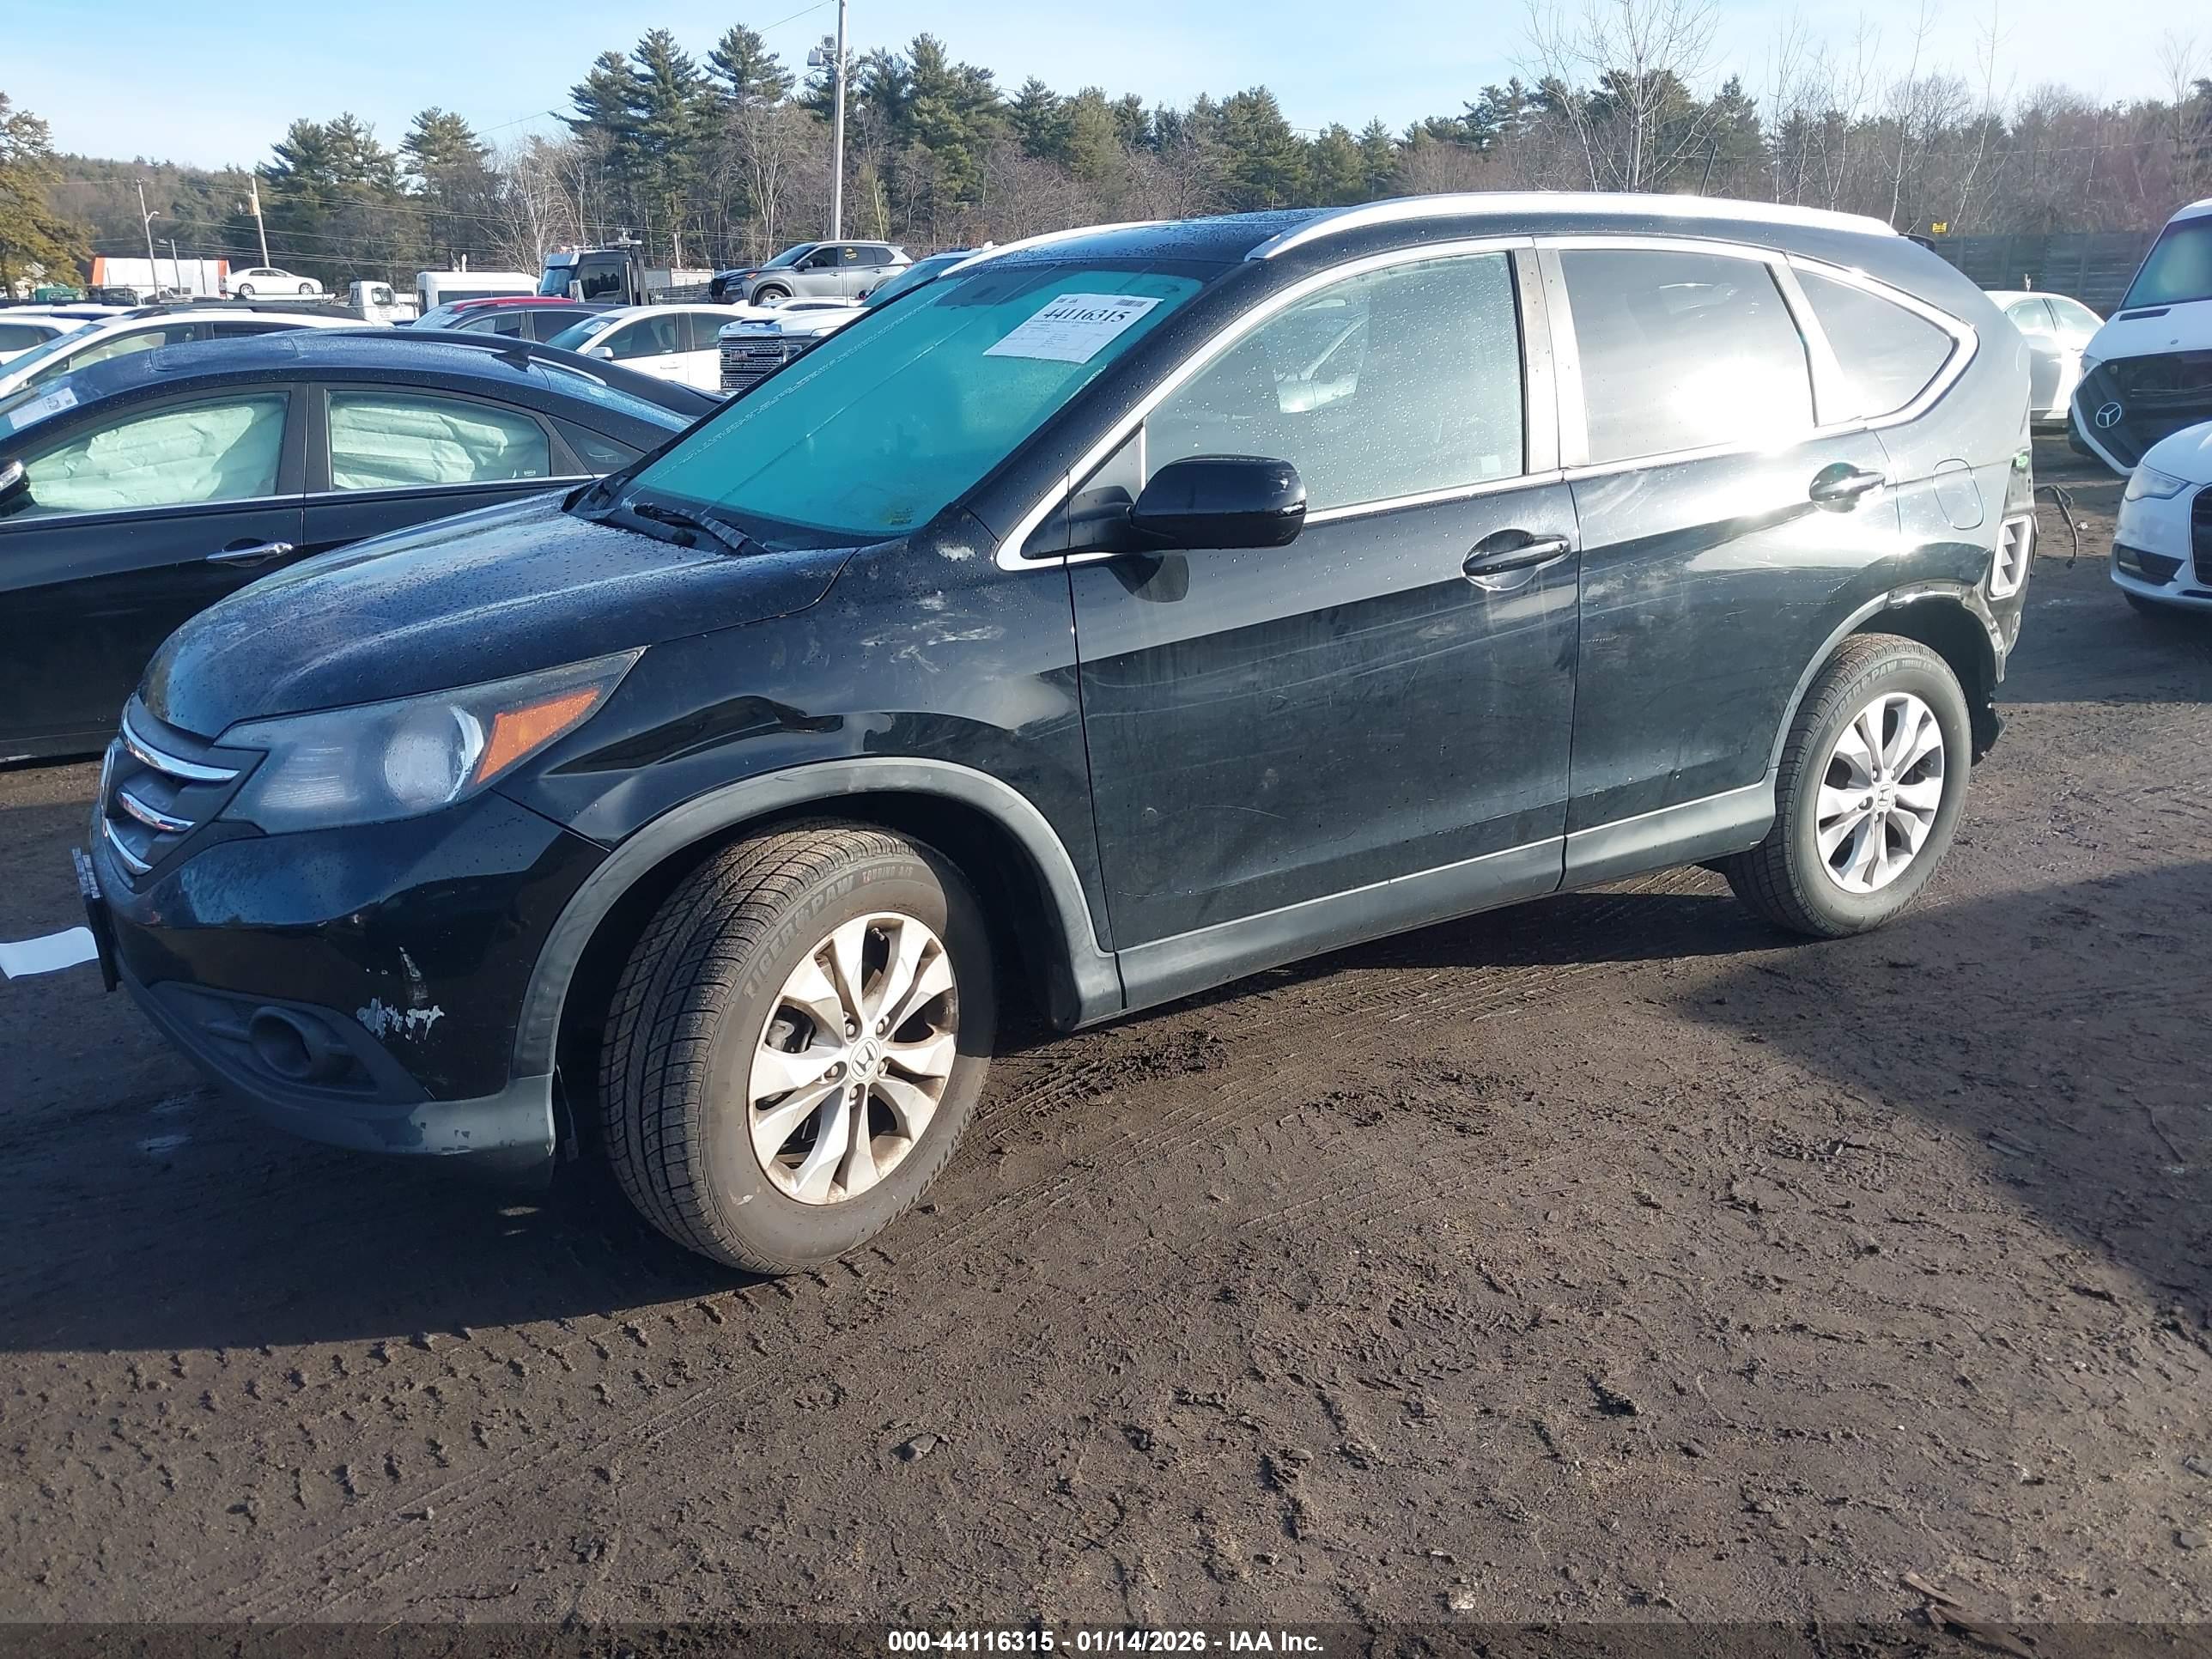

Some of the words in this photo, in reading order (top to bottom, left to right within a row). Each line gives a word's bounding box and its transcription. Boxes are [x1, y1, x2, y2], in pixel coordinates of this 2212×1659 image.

[1043, 307, 1133, 323] 44116315
[1871, 660, 1897, 681] PAW
[743, 924, 795, 998] TIGER
[810, 875, 855, 915] PAW
